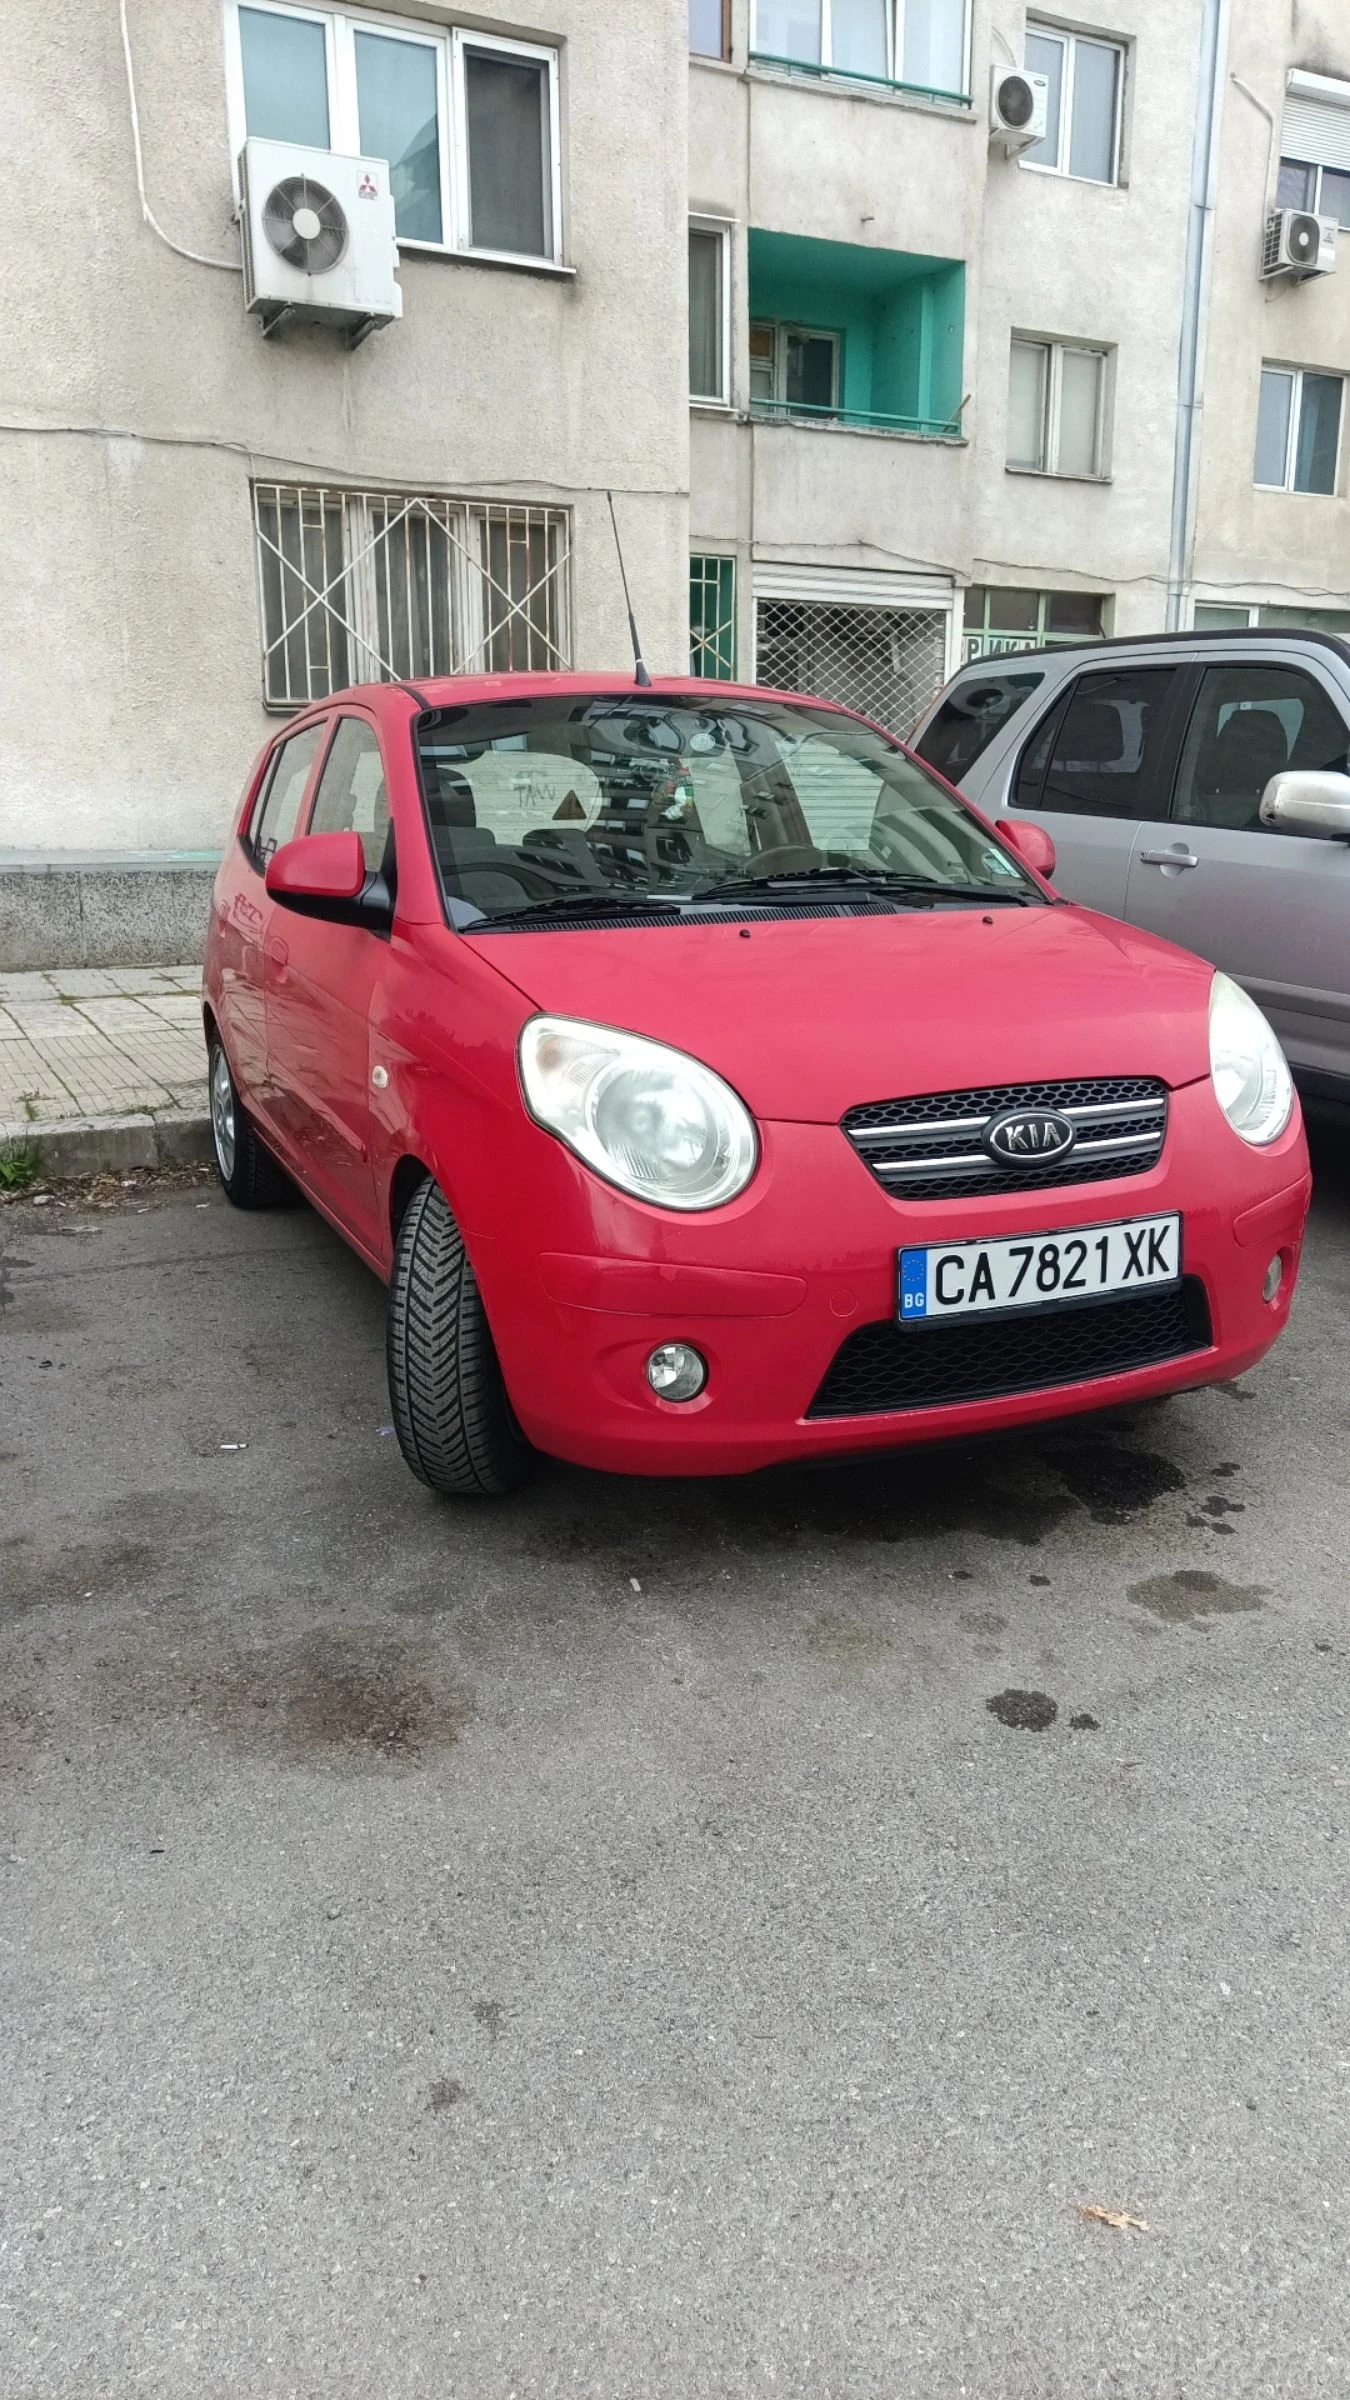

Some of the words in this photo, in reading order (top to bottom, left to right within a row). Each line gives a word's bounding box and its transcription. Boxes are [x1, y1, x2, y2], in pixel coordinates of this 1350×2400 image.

[1004, 1121, 1061, 1150] KIA
[935, 1252, 996, 1306] CA
[1008, 1235, 1109, 1298] 7821
[1122, 1224, 1171, 1280] XK
[904, 1292, 925, 1308] BG
